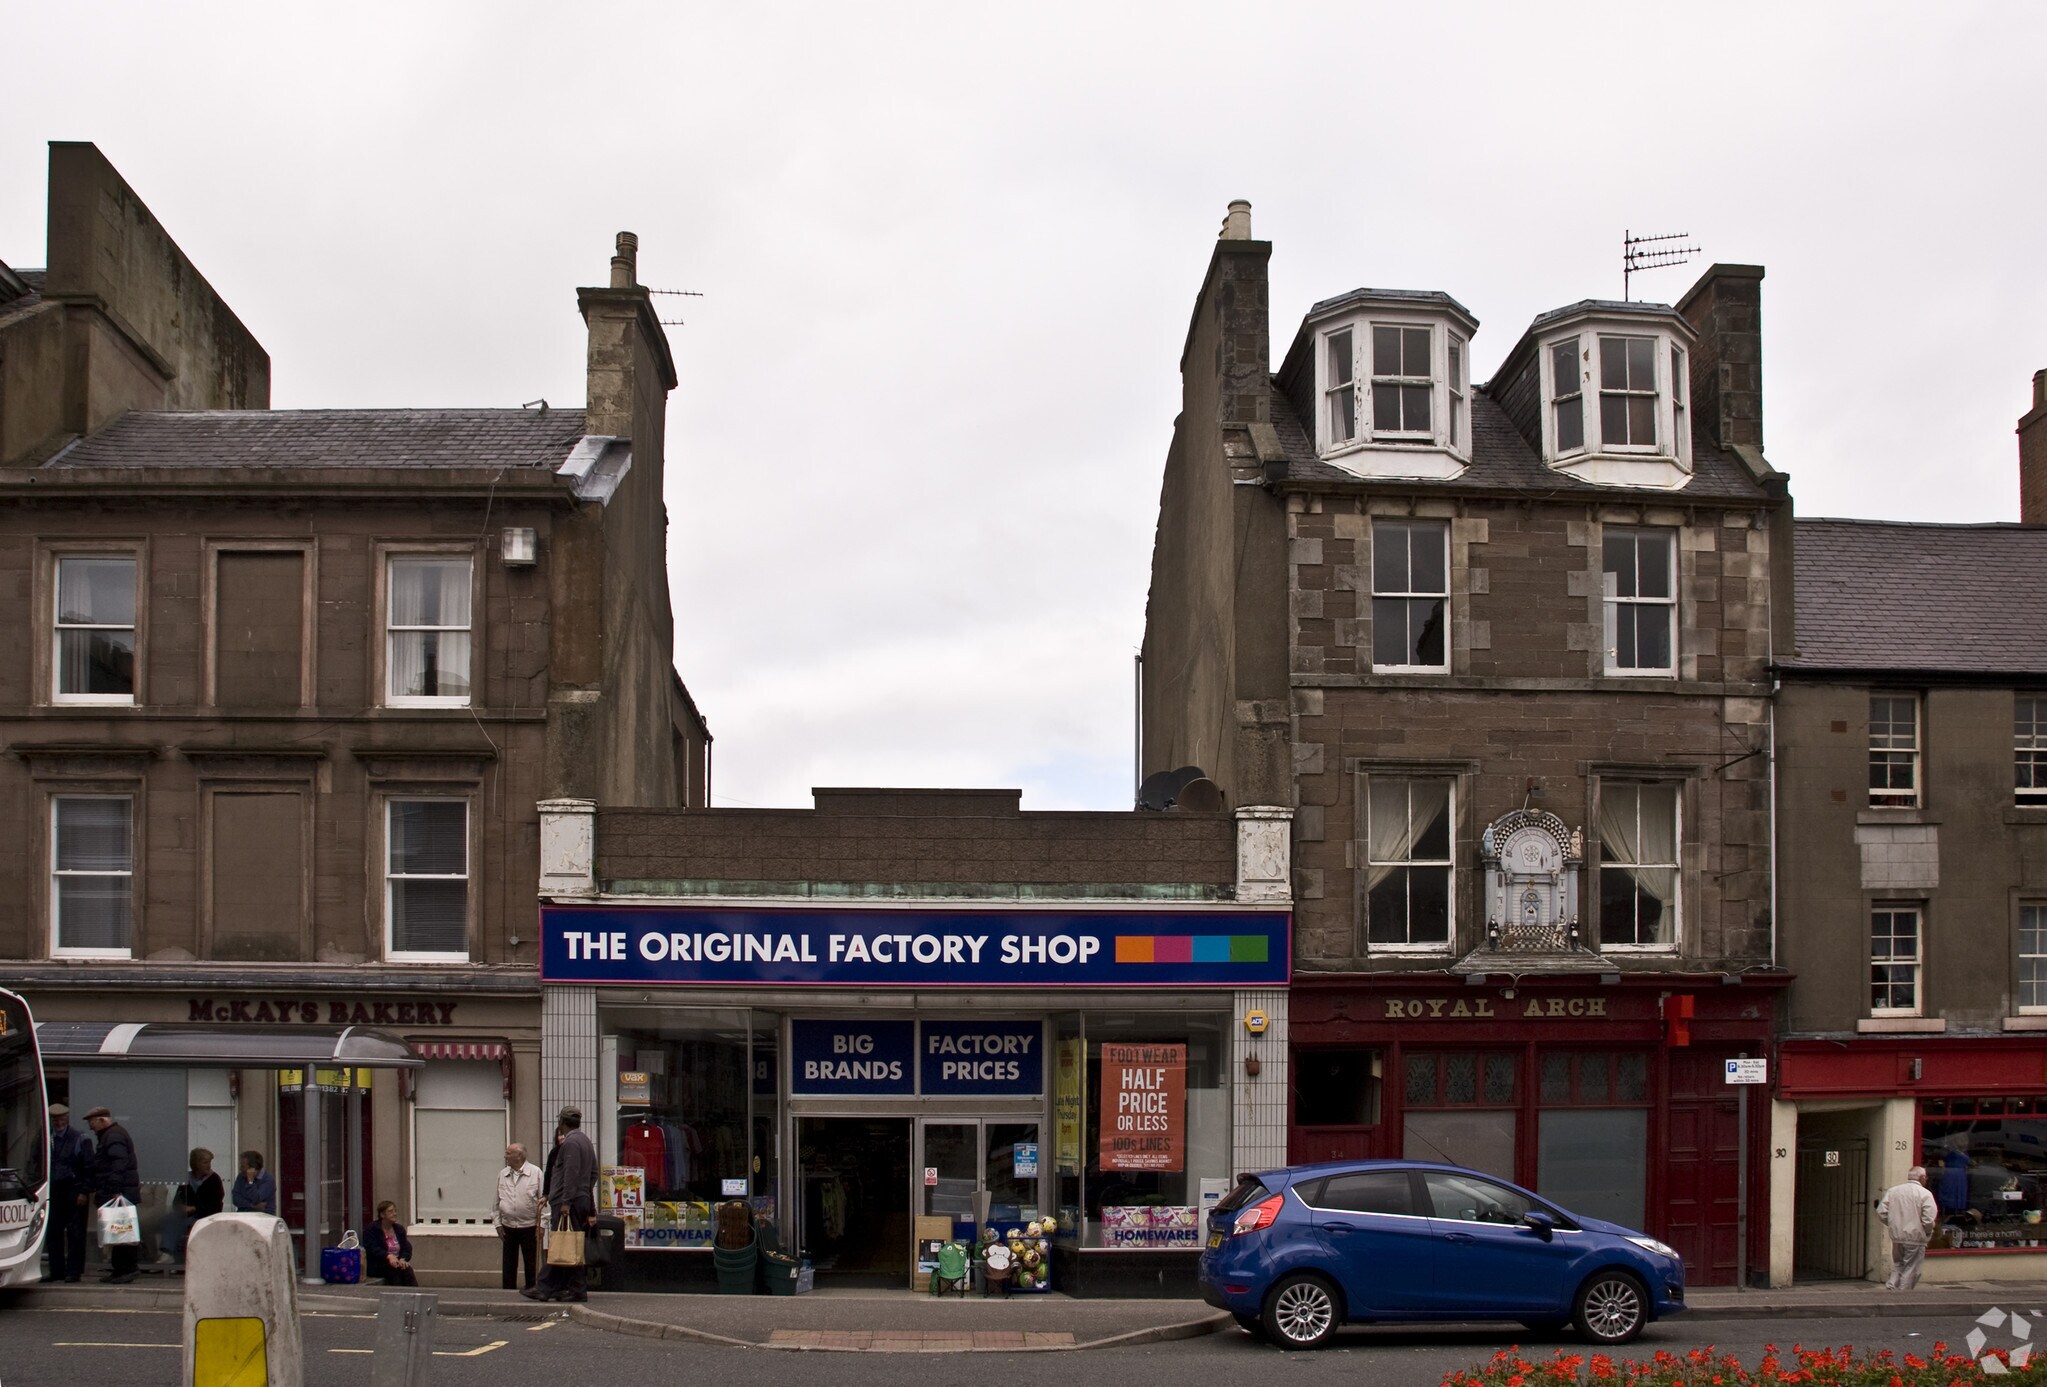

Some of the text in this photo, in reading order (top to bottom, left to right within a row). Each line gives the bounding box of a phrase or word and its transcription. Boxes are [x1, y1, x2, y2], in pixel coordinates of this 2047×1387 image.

[563, 931, 1100, 964] THE ORIGINAL FACTORY SHOP
[188, 999, 458, 1025] McKAY'S BAKERY
[1385, 998, 1607, 1018] ROYAL ARCH
[833, 1034, 874, 1054] BIG
[928, 1034, 1034, 1054] FACTORY
[1109, 1048, 1178, 1063] FOOTWEAR
[805, 1060, 903, 1080] BRANDS
[942, 1060, 1020, 1081] PRICES
[1729, 1063, 1736, 1072] P
[1121, 1068, 1166, 1090] HALF
[1118, 1092, 1168, 1113] PRICE
[1117, 1115, 1168, 1131] OR LESS
[1112, 1137, 1137, 1151] 100s
[1895, 1141, 1907, 1150] 28
[1775, 1148, 1787, 1159] 30
[1827, 1152, 1837, 1163] 30
[638, 1228, 713, 1240] FOOTWEAR
[1114, 1229, 1199, 1241] HOMEWARES
